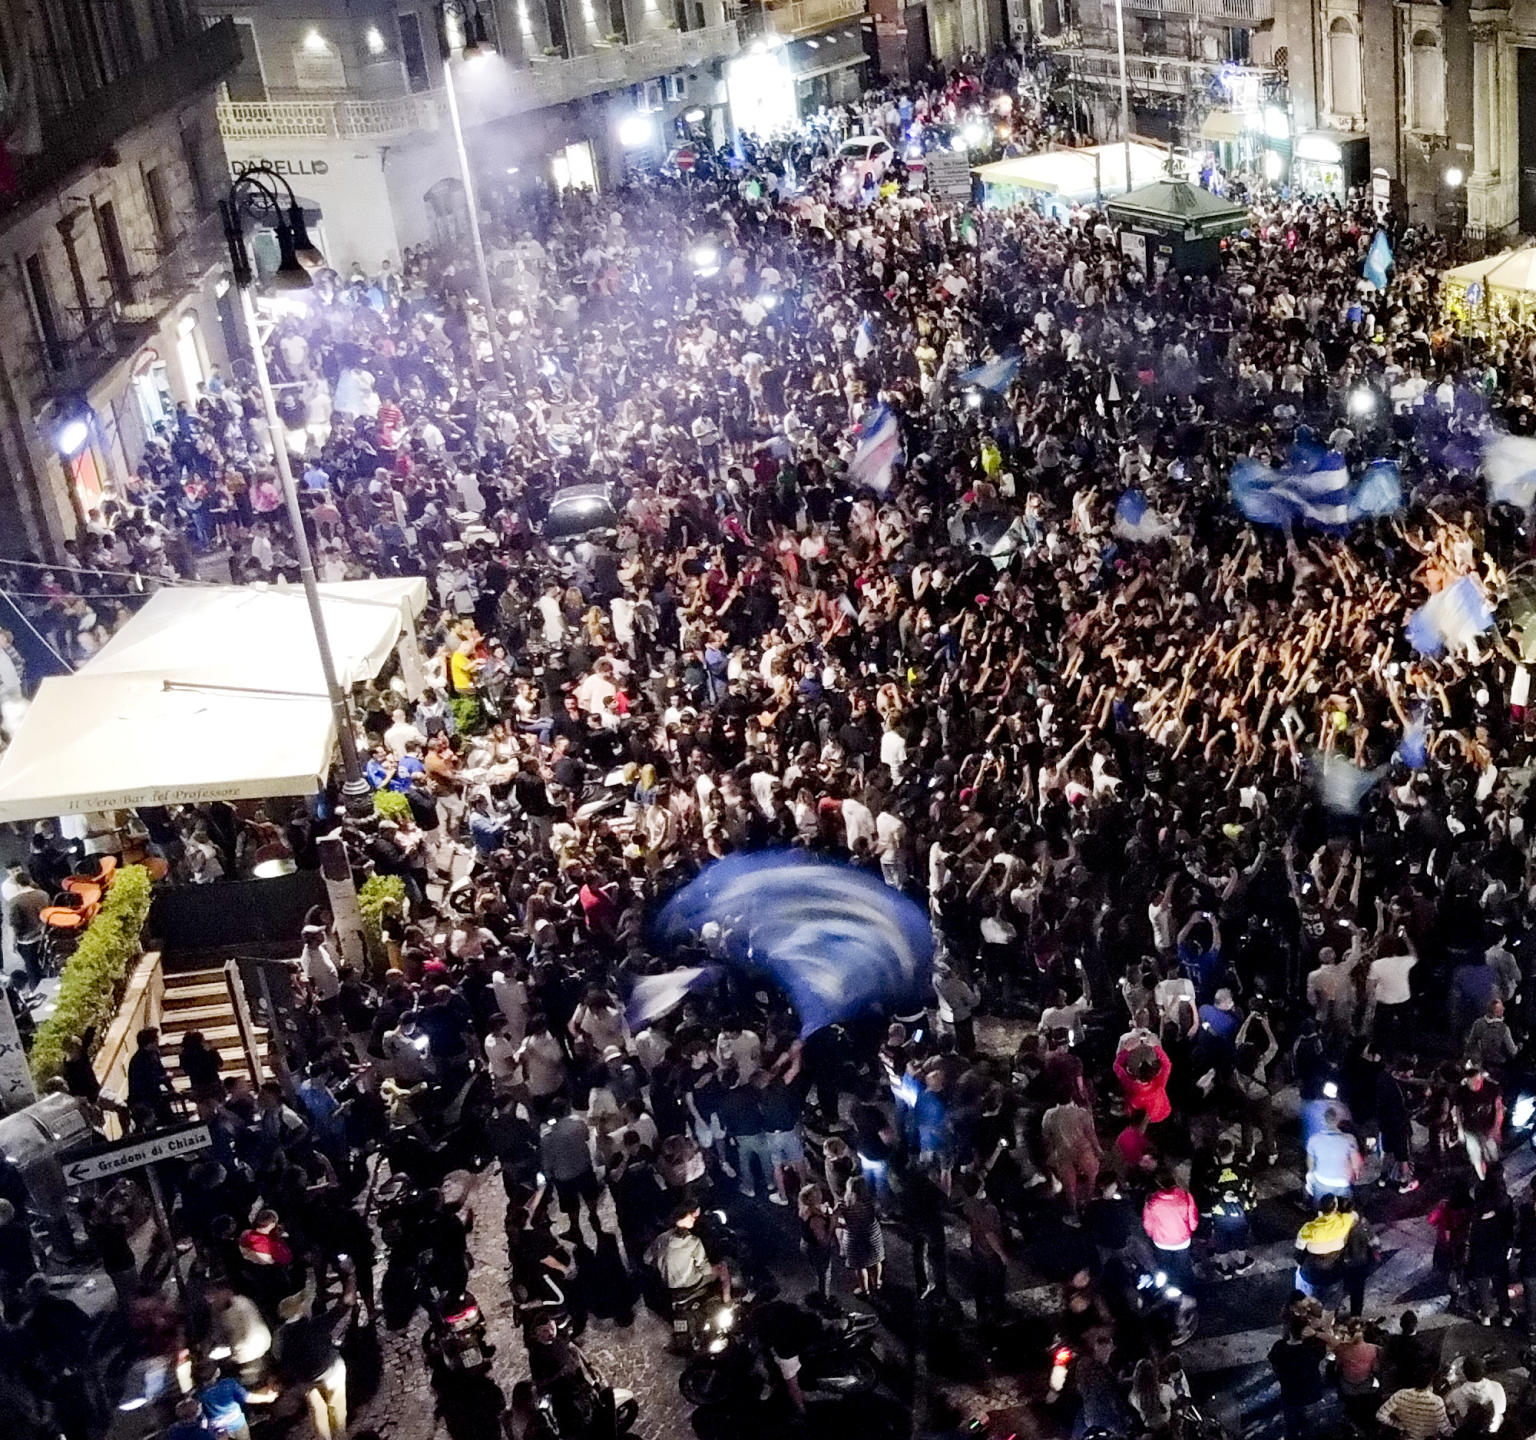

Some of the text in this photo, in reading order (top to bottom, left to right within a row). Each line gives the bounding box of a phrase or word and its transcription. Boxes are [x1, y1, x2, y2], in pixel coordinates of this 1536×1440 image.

[123, 794, 145, 805] Bar
[173, 787, 241, 799] Professore
[98, 1133, 207, 1171] Gradoni di Chiaia
